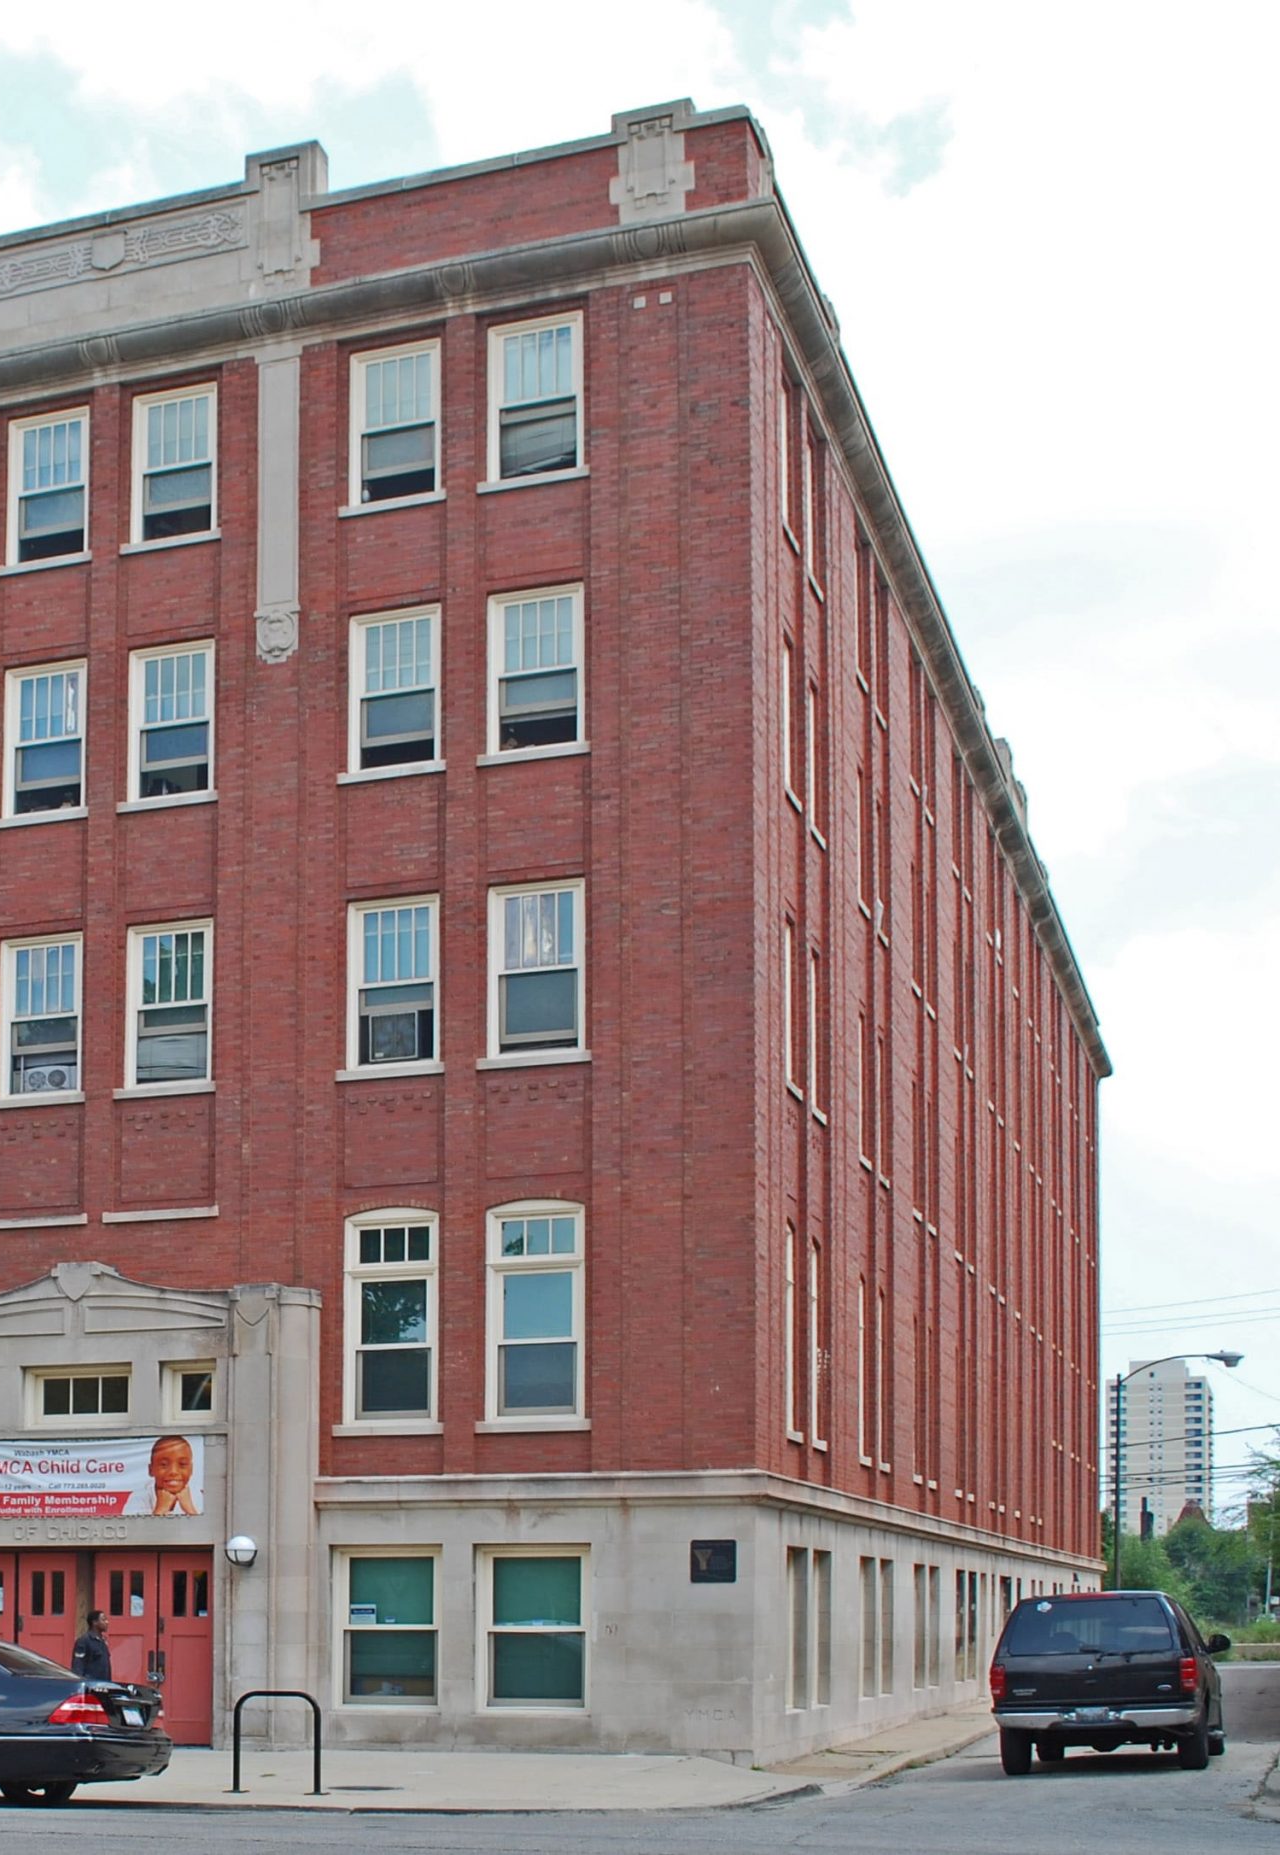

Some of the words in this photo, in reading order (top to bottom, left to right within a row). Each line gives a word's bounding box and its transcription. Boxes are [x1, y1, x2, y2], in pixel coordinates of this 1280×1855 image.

[46, 1447, 70, 1456] YMCA
[38, 1459, 81, 1474] Child
[85, 1459, 125, 1474] Care
[2, 1495, 41, 1507] Family
[44, 1495, 117, 1507] Membership
[24, 1506, 42, 1514] with
[45, 1506, 97, 1514] Enrollment!
[13, 1526, 38, 1541] OF
[47, 1525, 128, 1540] CHICAGO
